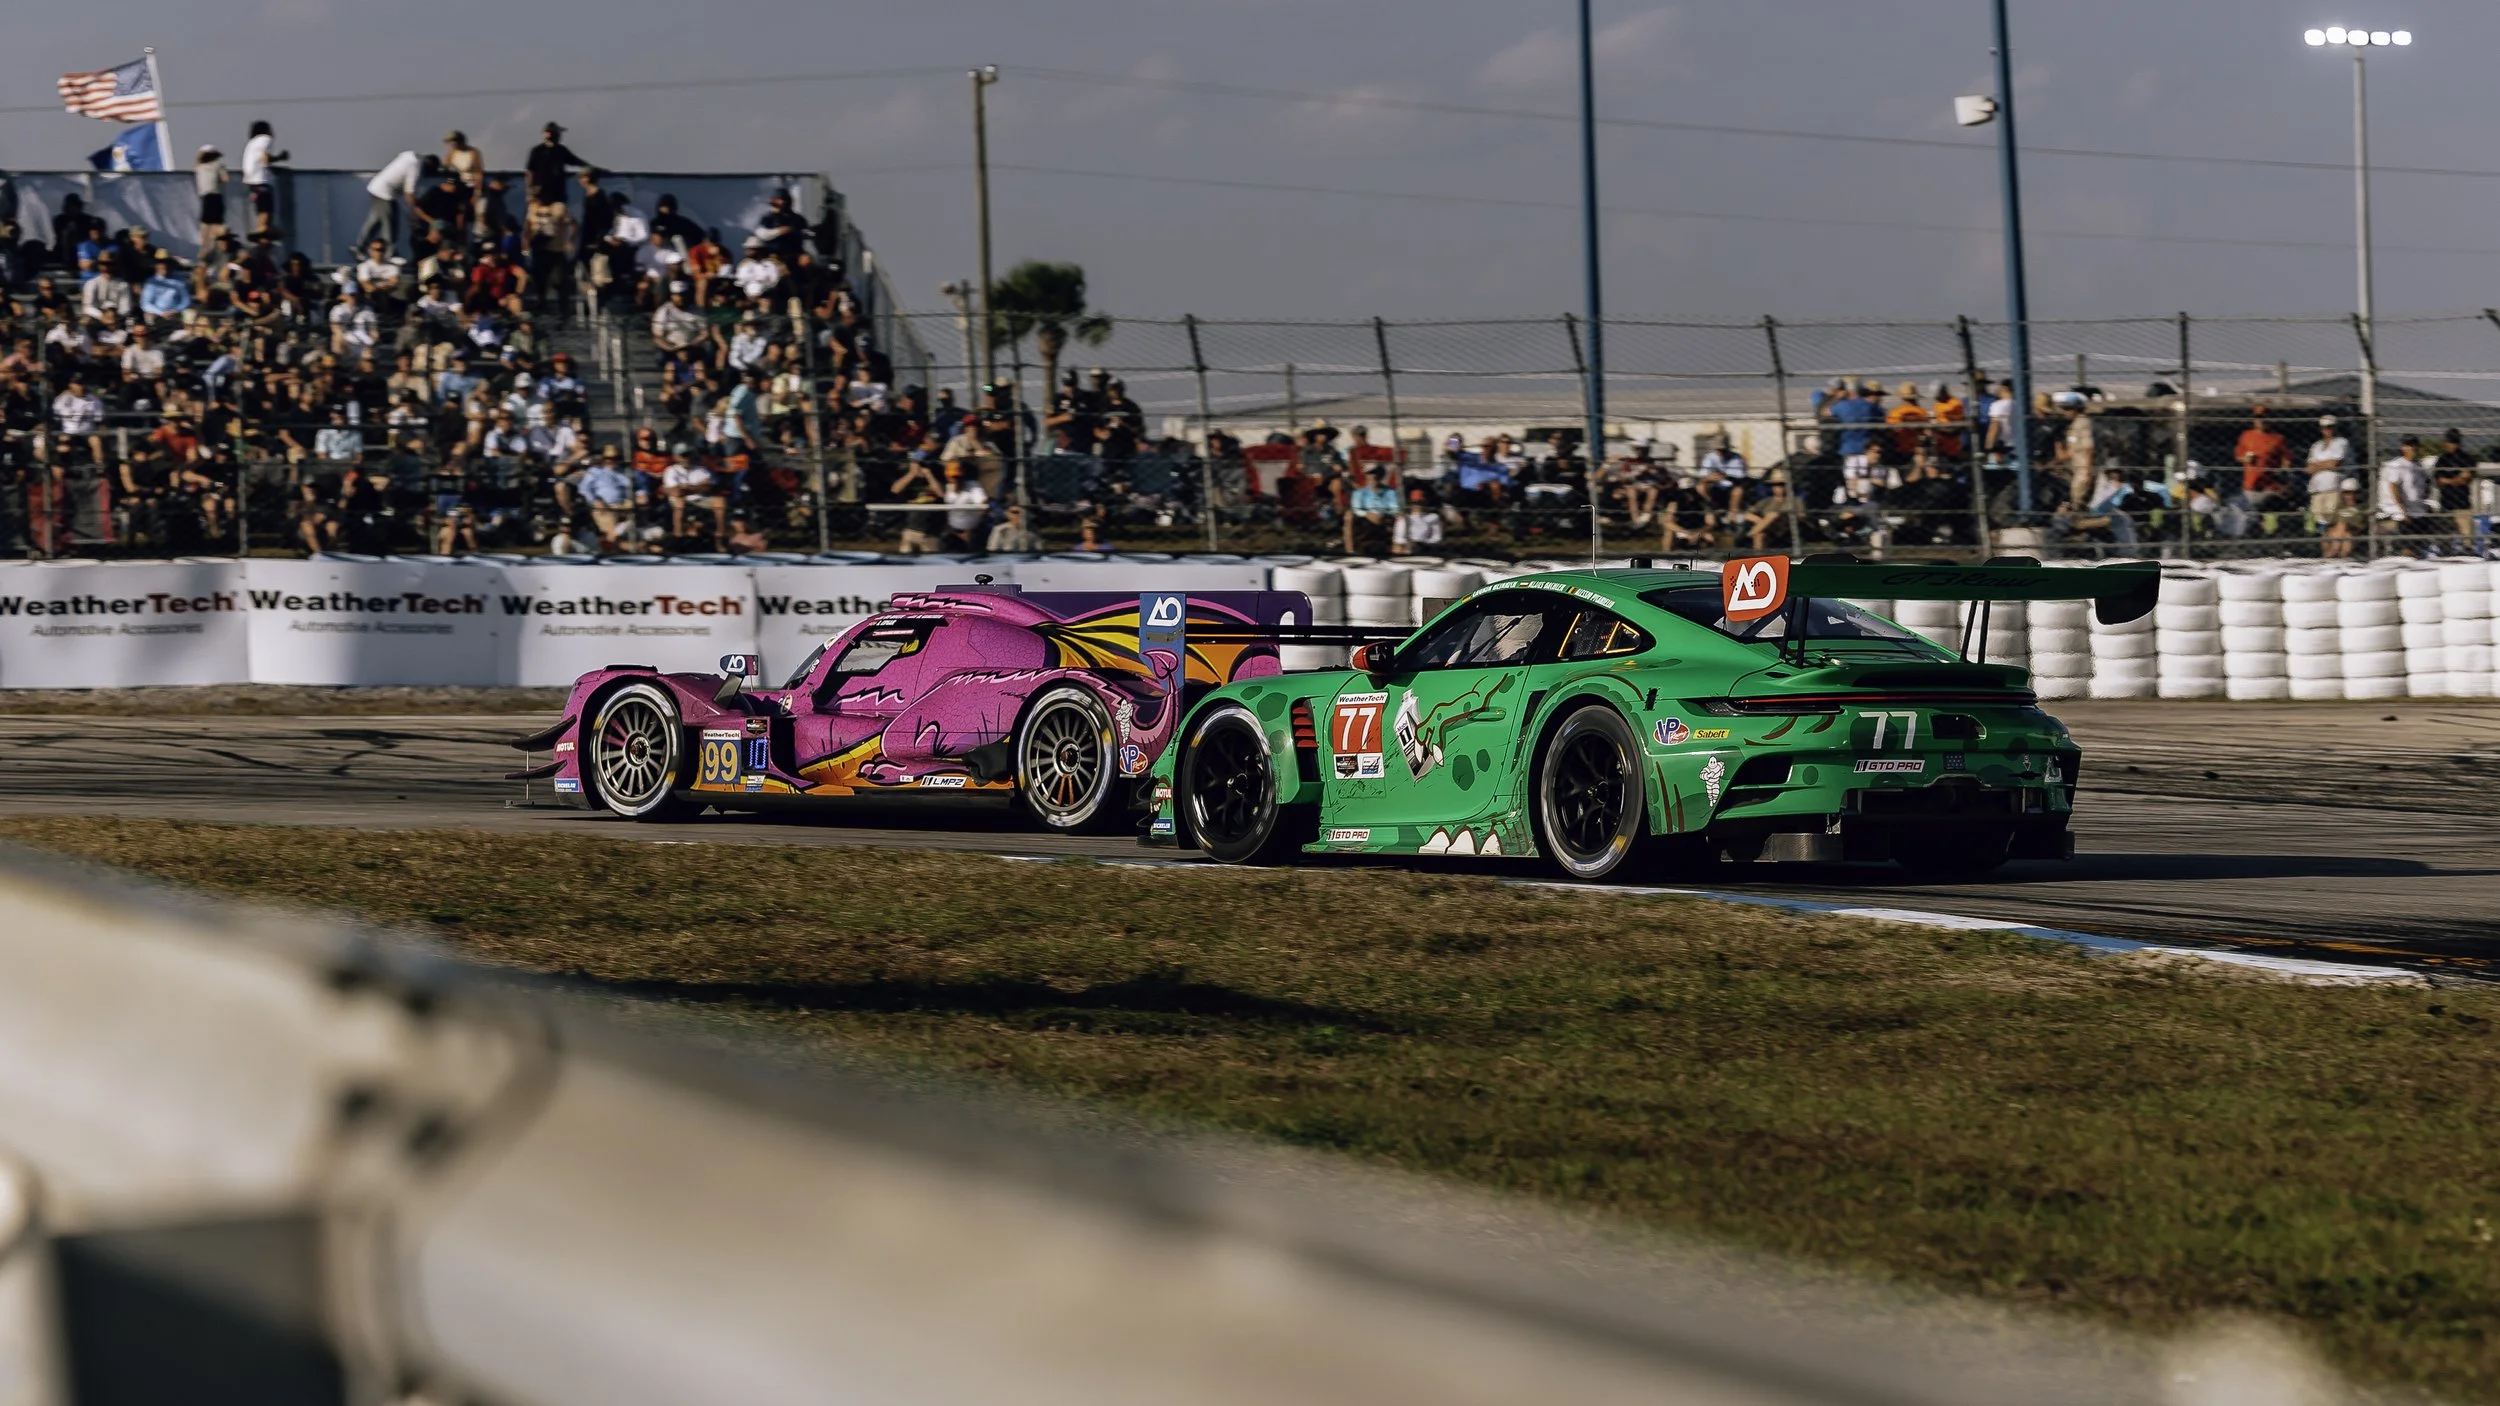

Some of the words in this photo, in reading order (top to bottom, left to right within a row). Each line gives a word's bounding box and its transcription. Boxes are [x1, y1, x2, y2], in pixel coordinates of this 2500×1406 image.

[0, 591, 235, 616] WeatherTech
[248, 589, 485, 615] WeatherTech
[500, 594, 744, 616] WeatherTech
[756, 595, 893, 615] Weathe
[1339, 694, 1386, 703] WeatherTech
[1339, 707, 1377, 751] 77
[1401, 730, 1410, 743] 1
[1655, 717, 1681, 745] VP
[1696, 729, 1726, 739] Sabelt
[1858, 711, 1918, 749] 77
[556, 741, 575, 753] MOTUL
[705, 741, 738, 782] 99
[1120, 745, 1140, 773] VP
[1868, 761, 1893, 771] GTD
[1896, 761, 1922, 771] PRO
[1155, 787, 1172, 798] MOTUL
[1335, 831, 1351, 839] GTD
[1352, 831, 1369, 839] PRO
